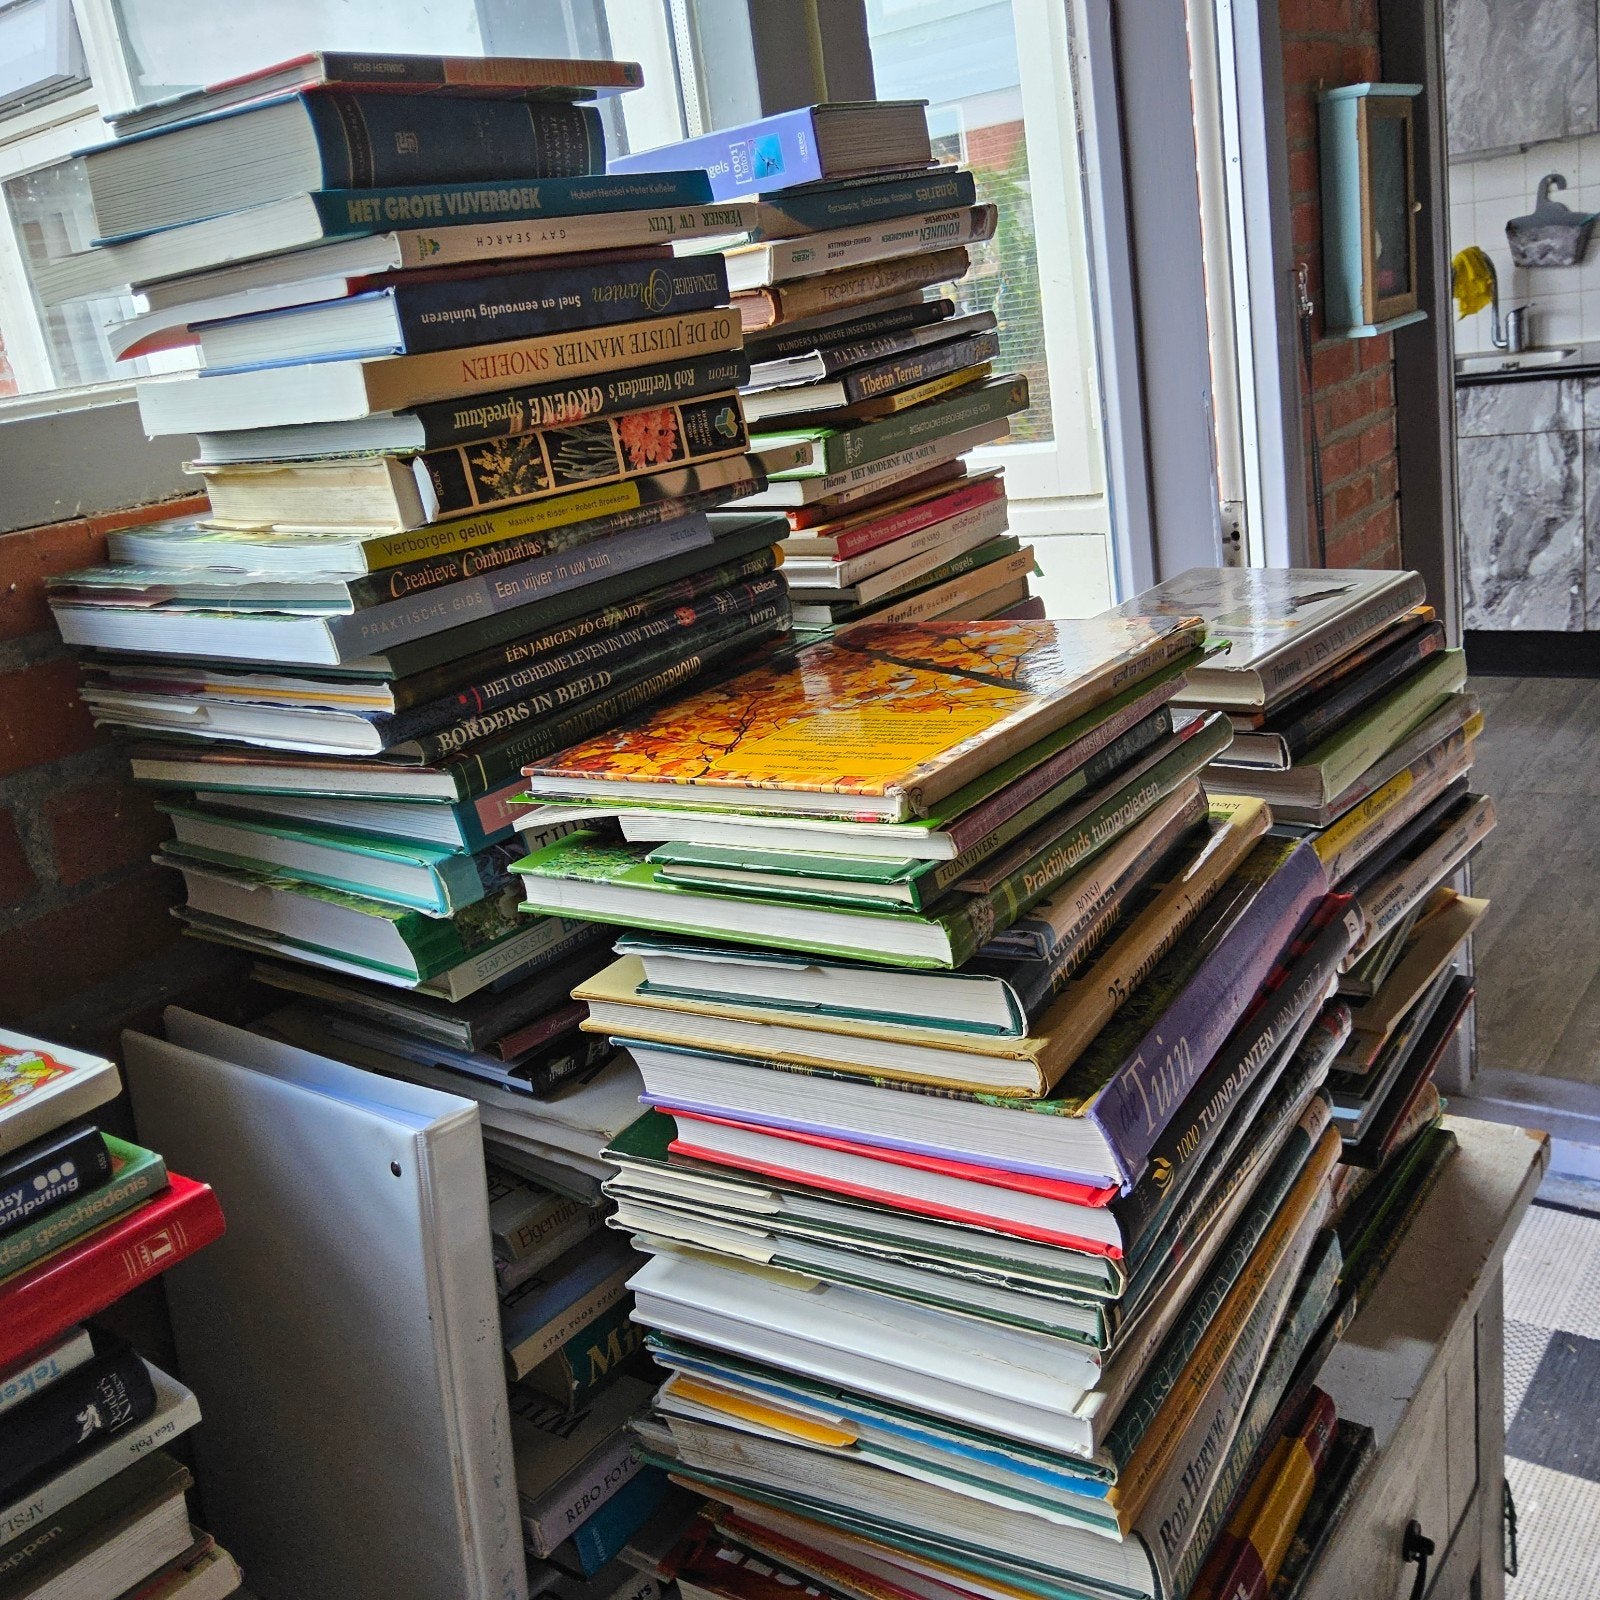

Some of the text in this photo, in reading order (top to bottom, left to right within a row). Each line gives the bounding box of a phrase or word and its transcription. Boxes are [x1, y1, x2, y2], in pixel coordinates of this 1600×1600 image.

[347, 187, 541, 223] HET GROTE VIJVERBOEK
[476, 231, 567, 247] GAY SEARCH
[791, 252, 810, 263] REBO
[421, 295, 581, 325] Snel en eenvoudig tuinieren
[461, 319, 731, 383] OP DE JUISTE MANIER SNOEIEN
[833, 346, 866, 364] MAINE
[608, 372, 672, 400] Verlinden's
[674, 368, 695, 387] Rob
[708, 363, 740, 382] Tirion
[860, 371, 894, 396] Tibetan
[894, 362, 924, 384] Terrier
[530, 384, 604, 426] GROENE
[822, 446, 937, 491] Thieme HET MODERNE AQUARIUM
[575, 499, 598, 512] Robert
[381, 521, 496, 557] Verborgen geluk
[390, 539, 541, 600] Creatieve Combinaties
[741, 557, 768, 575] TERRA
[951, 556, 975, 573] vogels
[360, 605, 448, 639] PRAKTISCHE
[494, 580, 520, 600] Een
[521, 569, 554, 593] vijver
[556, 564, 568, 581] in
[569, 561, 588, 577] uw
[588, 552, 611, 573] tuin
[530, 629, 577, 657] JARIGEN
[595, 604, 641, 630] GEZAAID
[483, 618, 671, 699] HET GEHEIME LEVEN IN UW TUIN
[437, 671, 612, 752] BORDERS IN BEELD
[559, 656, 702, 736] PRAKTISCH TUINONDERHOUD
[940, 834, 1000, 882] TUINVIJVERS
[1023, 781, 1160, 896] Praktijkgids tuinprojecten
[476, 957, 501, 978] STAP
[500, 940, 530, 966] VOOR
[527, 925, 553, 951] STAP
[1051, 898, 1122, 994] ENCYCLOPEDIE
[1108, 977, 1128, 1002] 25
[1122, 1035, 1195, 1137] Tuin
[1176, 1123, 1200, 1163] 1000
[1198, 1025, 1275, 1133] TUINPLANTEN
[543, 1289, 618, 1351] STAP VOOR STAP
[129, 1421, 176, 1454] Bea Pols
[1181, 1409, 1228, 1495] HERWIG
[565, 1485, 601, 1524] REBO
